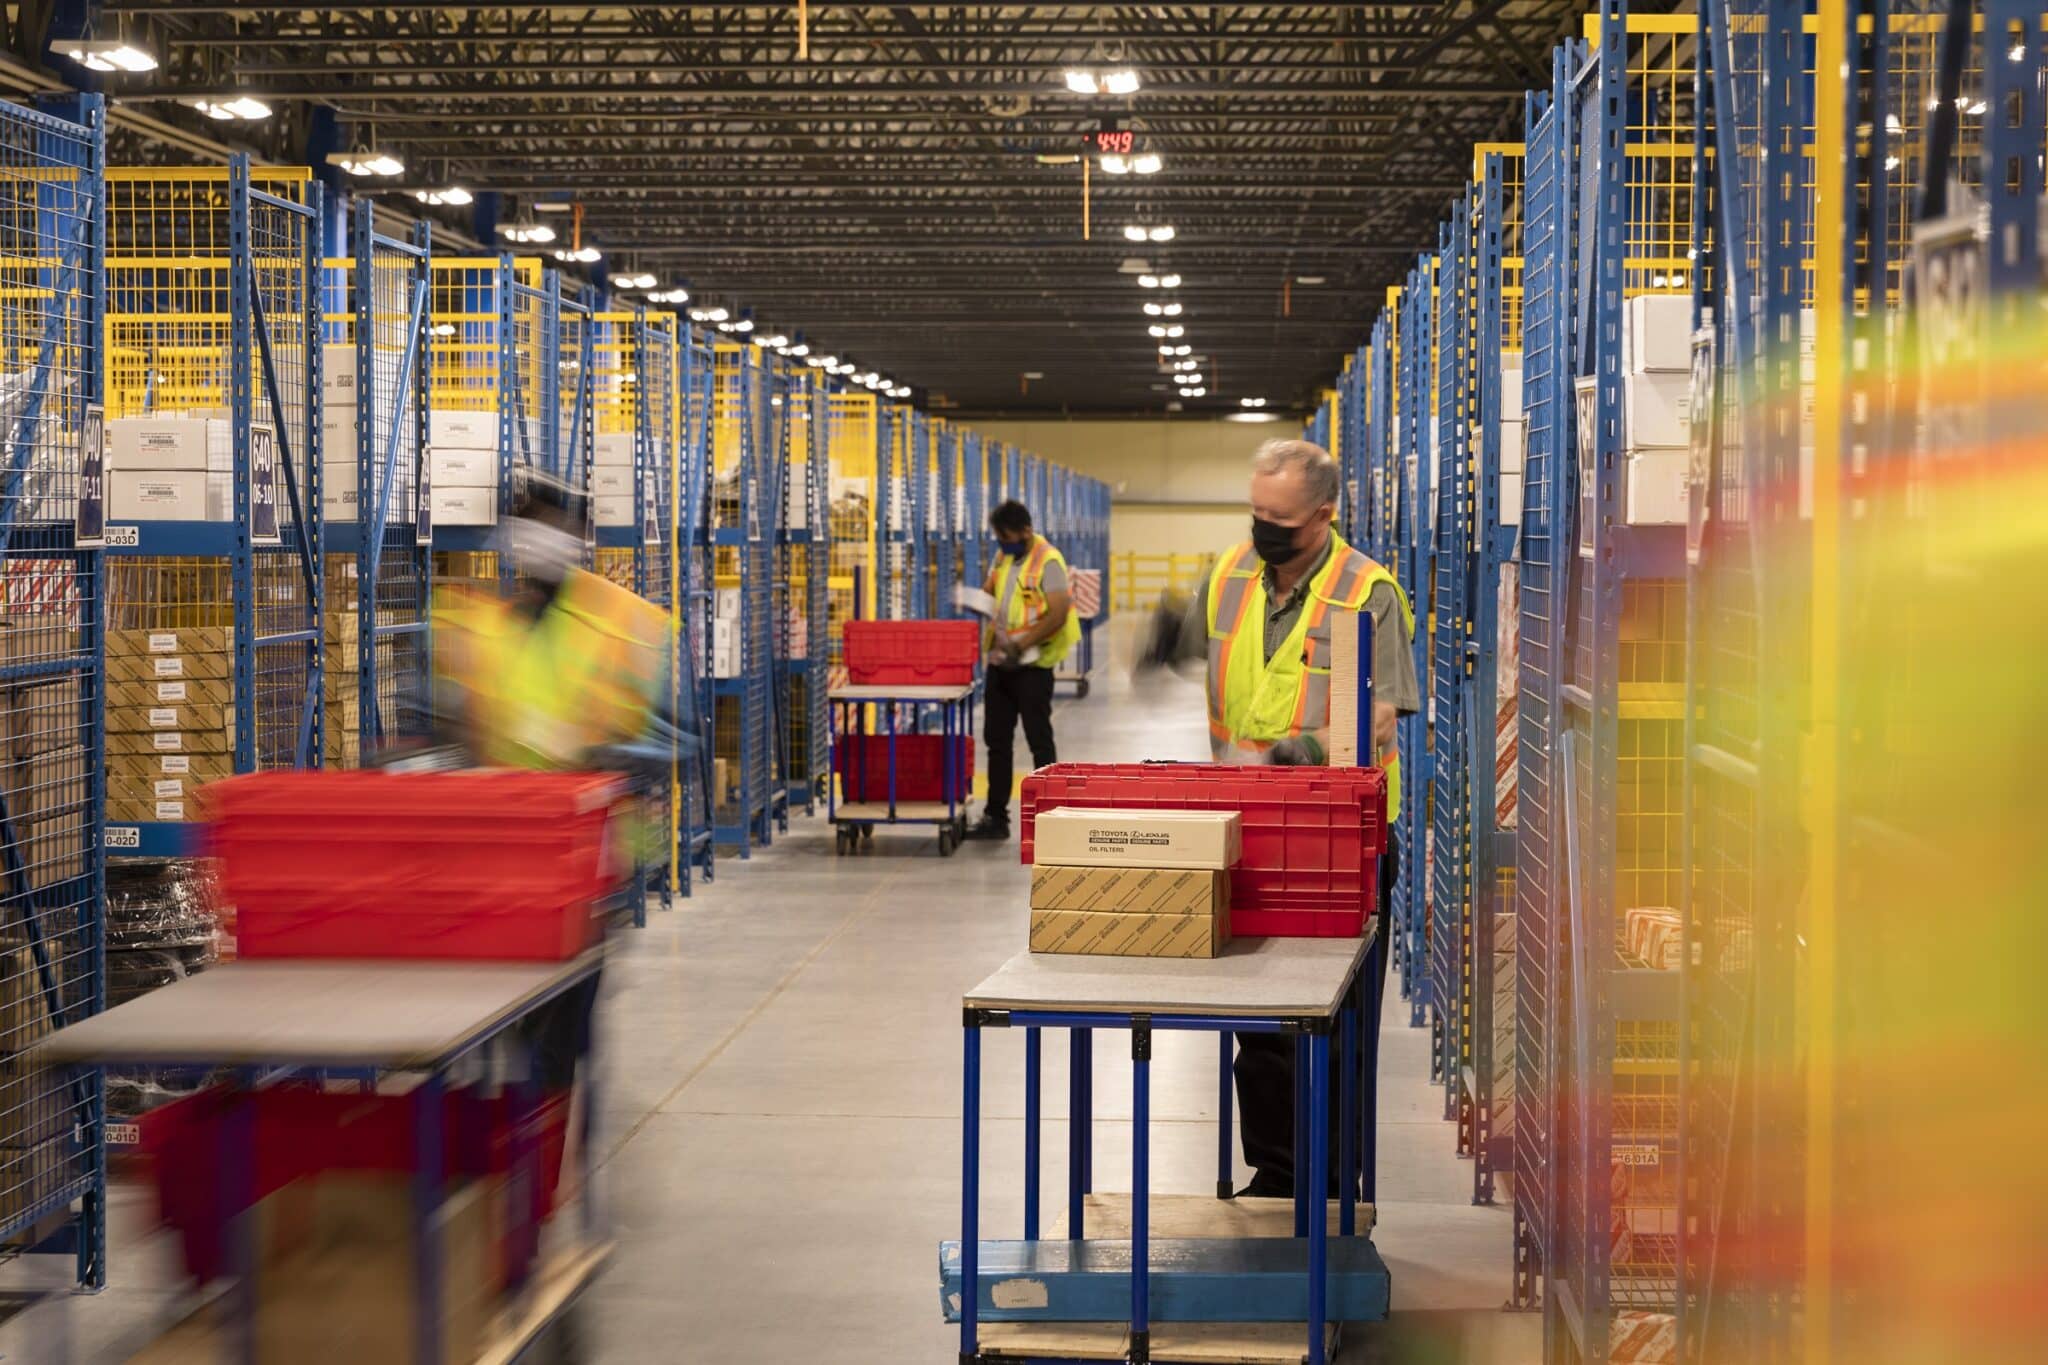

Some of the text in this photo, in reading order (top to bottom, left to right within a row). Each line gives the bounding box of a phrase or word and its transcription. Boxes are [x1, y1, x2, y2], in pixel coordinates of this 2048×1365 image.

[253, 434, 271, 473] 640
[105, 535, 136, 545] 0-03D
[106, 836, 137, 845] 0-02D
[106, 1133, 137, 1142] 0-01D
